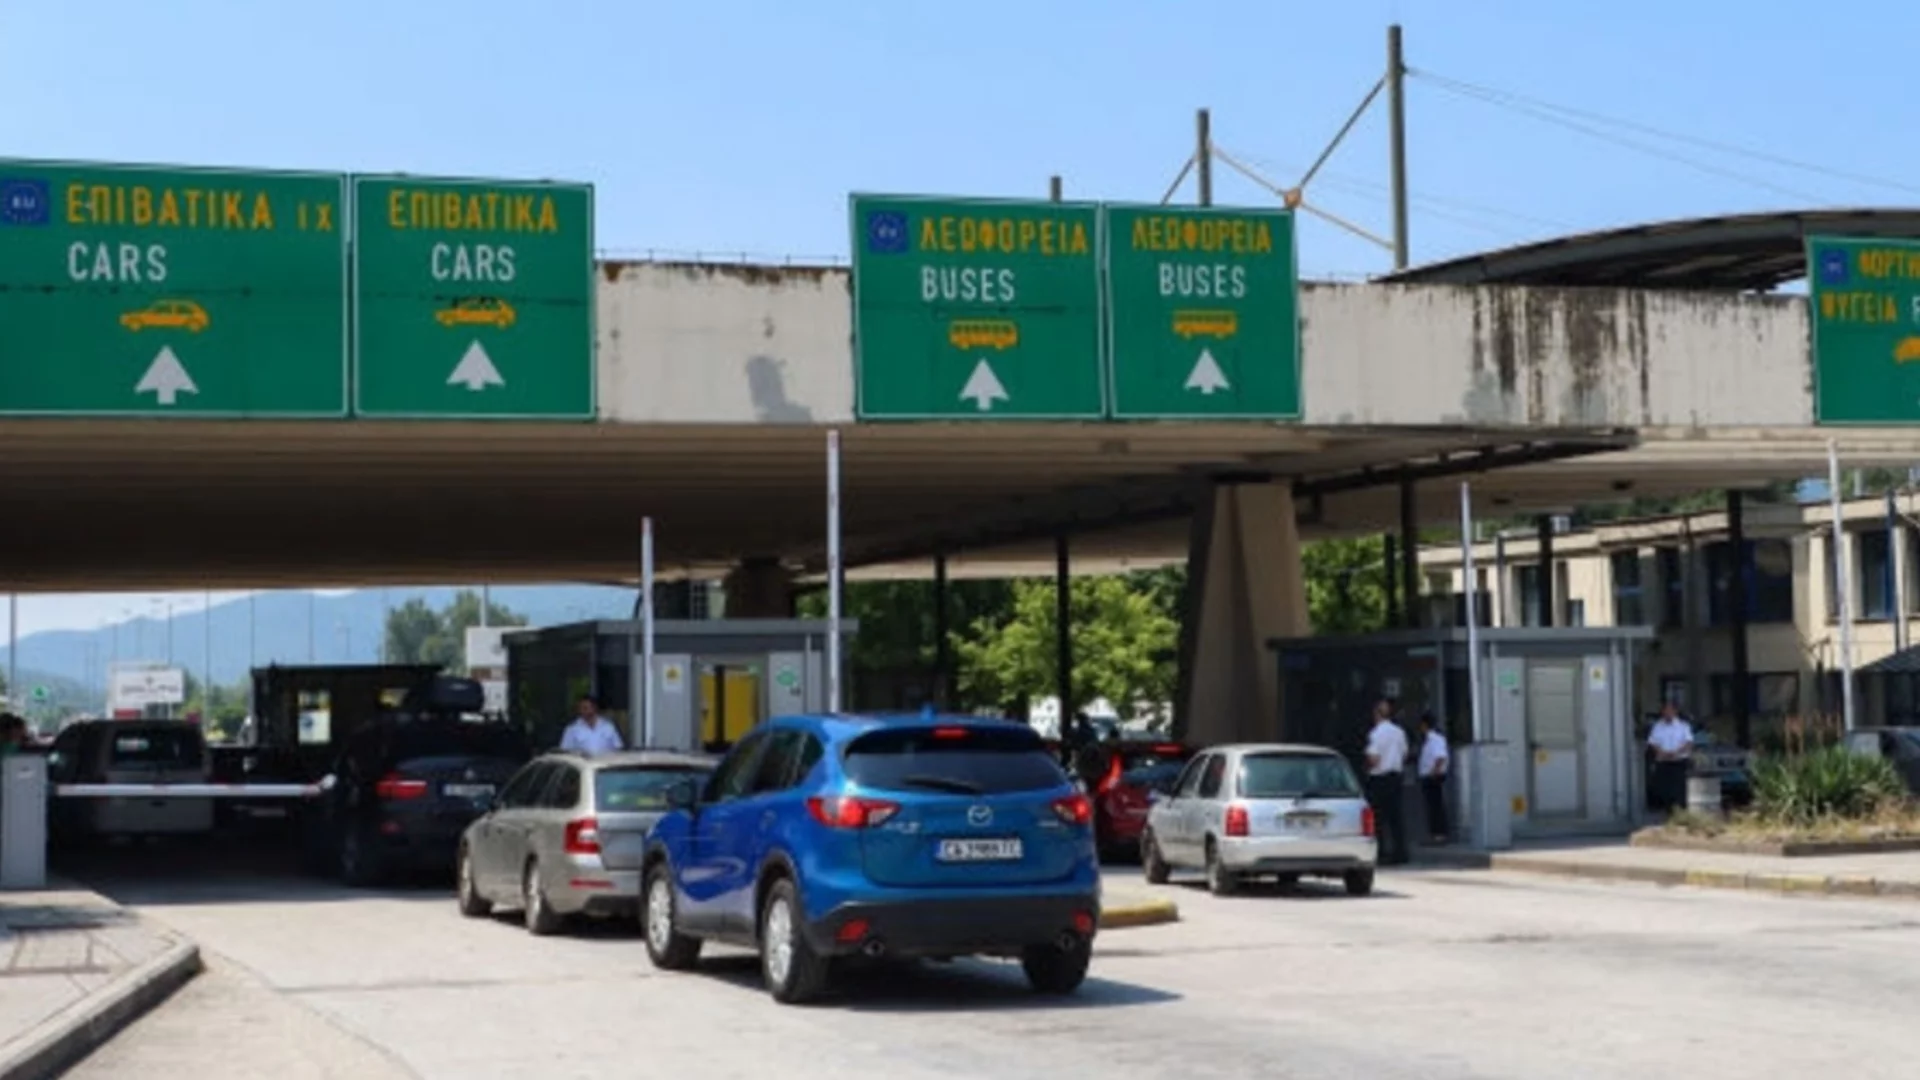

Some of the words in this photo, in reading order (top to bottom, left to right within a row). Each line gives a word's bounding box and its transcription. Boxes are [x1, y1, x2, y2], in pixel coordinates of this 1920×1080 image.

[66, 183, 273, 231] ΕΠΙΒΑΤΙΚΑ
[390, 188, 558, 233] ΕΠΙΒΑΤΙΚΑ
[920, 215, 1089, 256] ΛΕΩΦΟΡΕΙΑ
[1132, 215, 1273, 255] ΛΕΩΦΟΡΕΙΑ
[67, 241, 168, 283] CARS
[430, 241, 517, 282] CARS
[1158, 261, 1247, 299] BUSES
[921, 264, 1016, 303] BUSES
